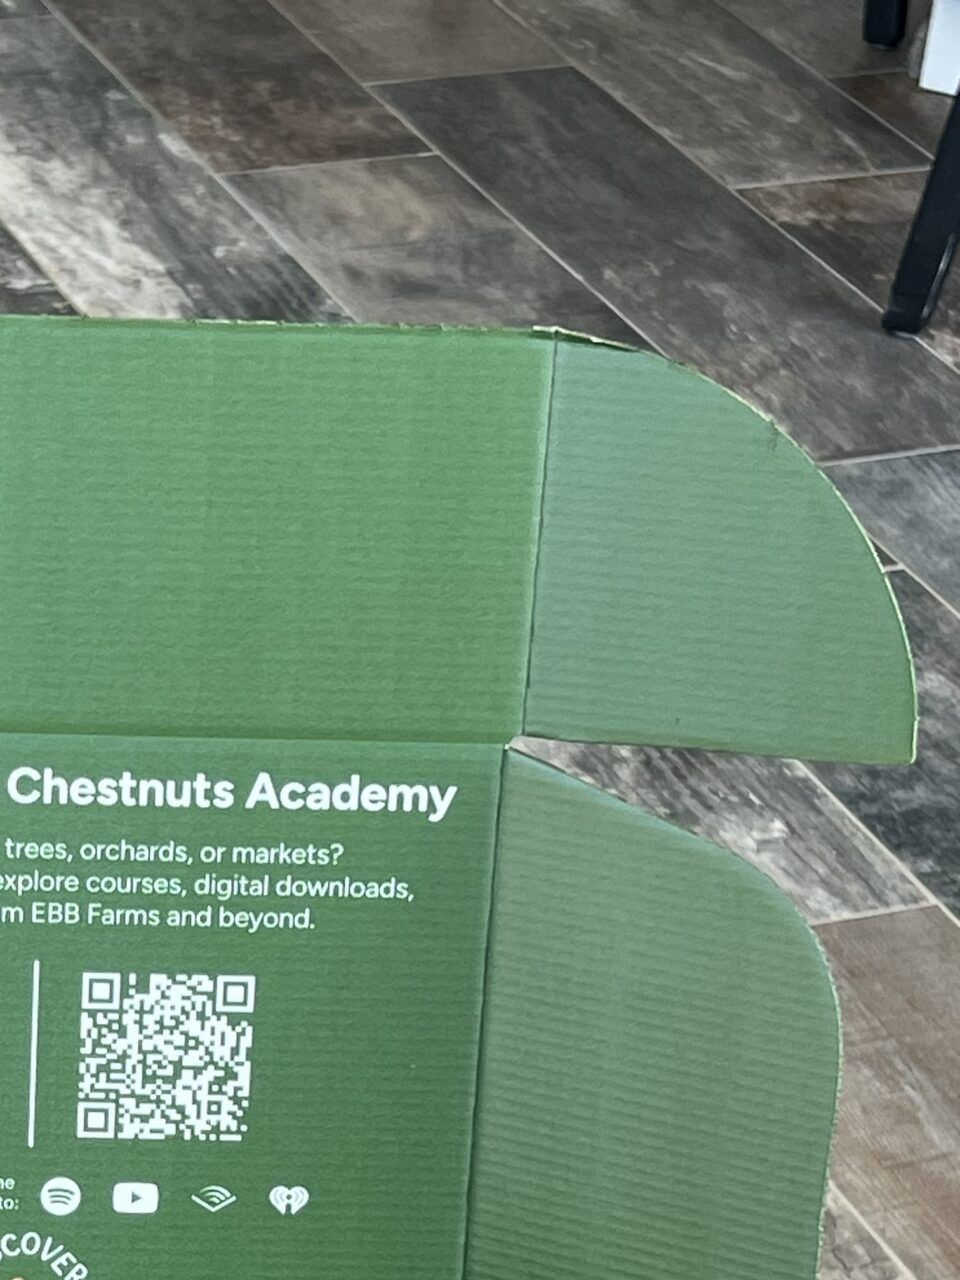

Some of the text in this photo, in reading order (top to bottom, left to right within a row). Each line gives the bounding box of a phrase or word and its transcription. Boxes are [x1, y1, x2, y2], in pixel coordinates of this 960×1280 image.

[7, 766, 235, 809] Chestnuts
[244, 771, 458, 823] Academy
[4, 837, 73, 863] trees,
[79, 838, 193, 866] orchards,
[200, 845, 227, 864] or
[232, 842, 345, 866] markets?
[85, 876, 187, 898] courses,
[194, 873, 270, 901] digital
[275, 874, 414, 903] downloads,
[31, 901, 80, 924] EBB
[87, 902, 161, 926] Farms
[166, 905, 212, 927] and
[218, 905, 316, 934] beyond.
